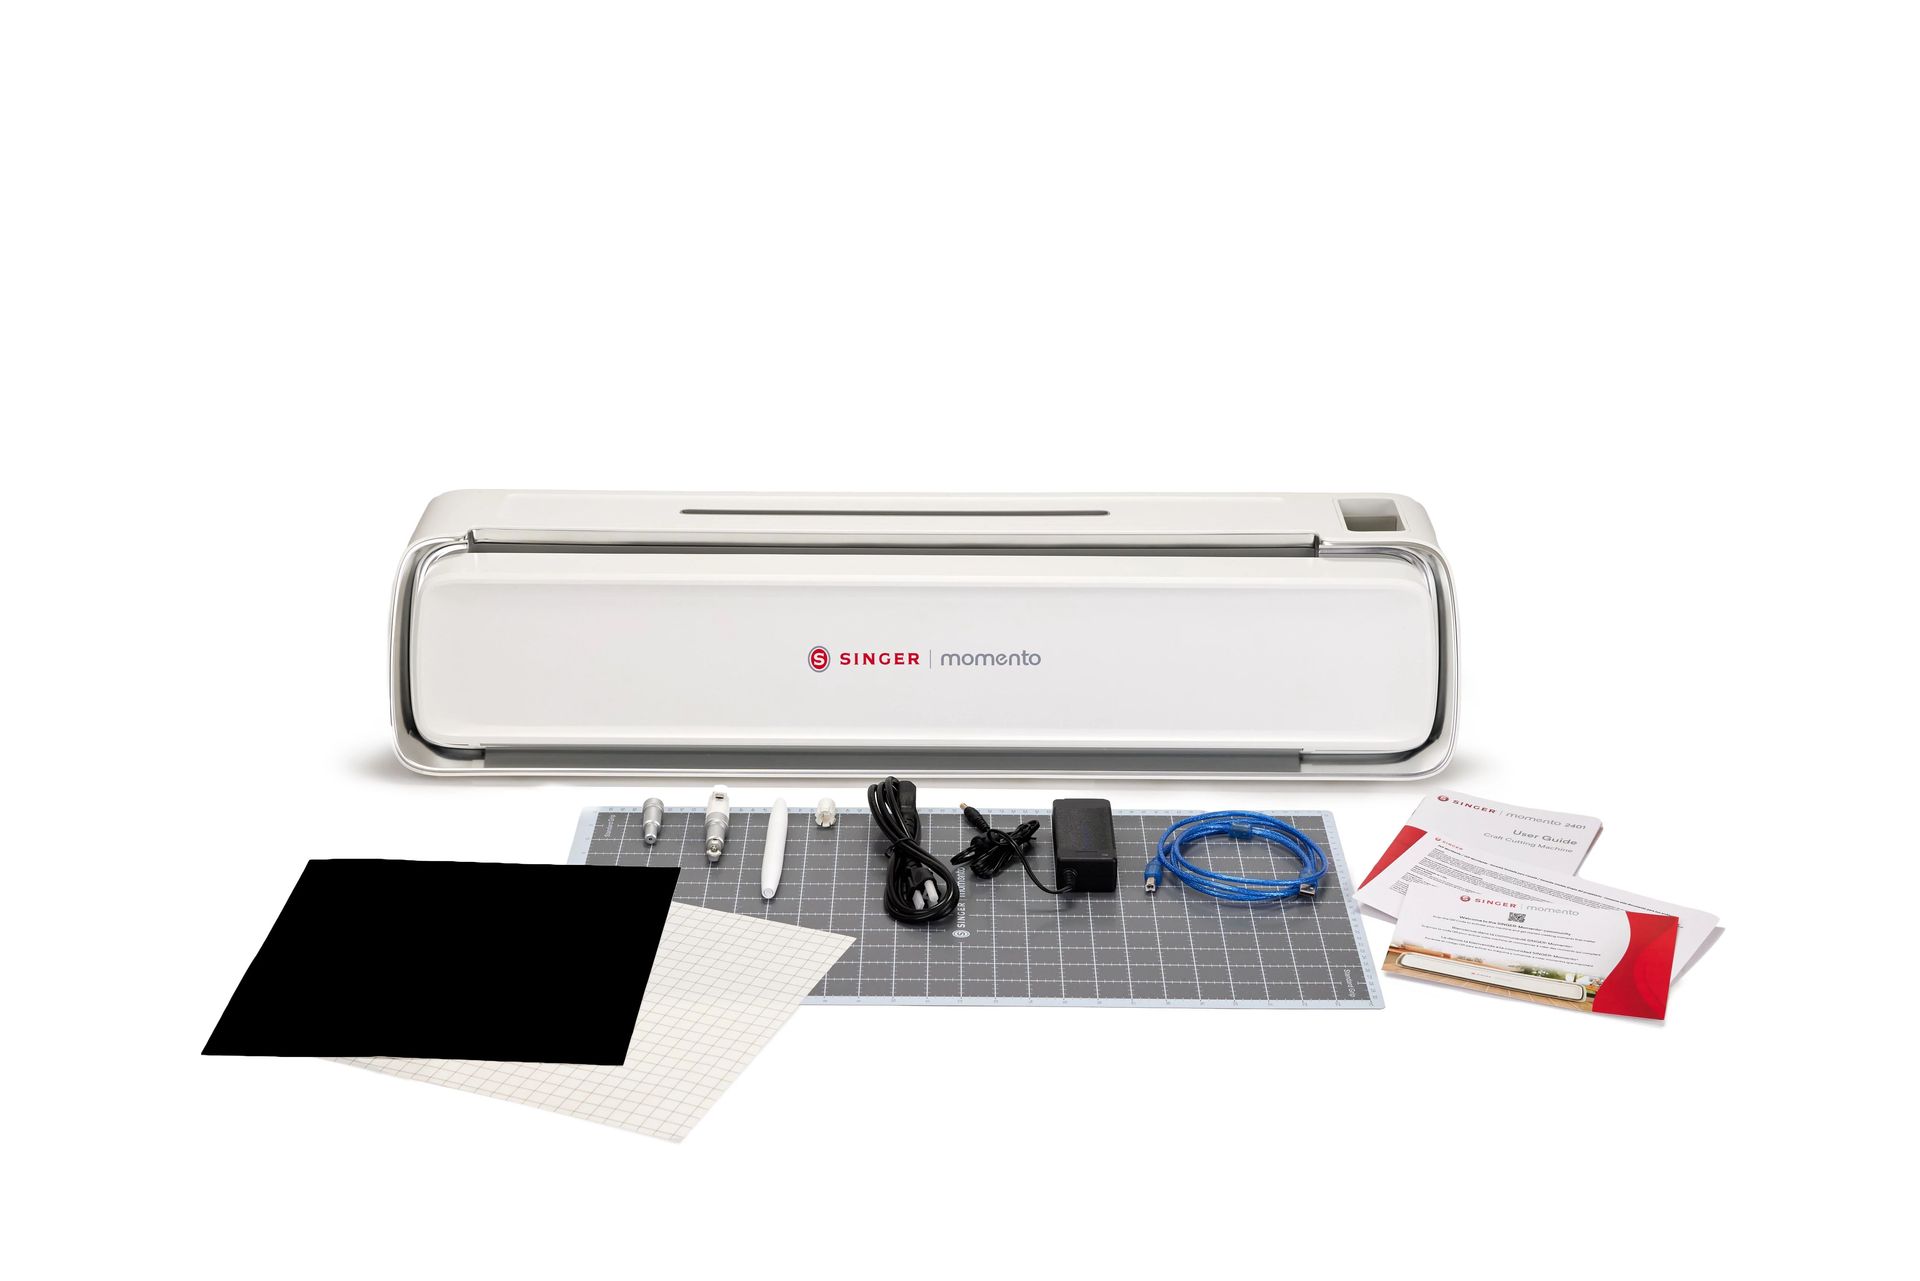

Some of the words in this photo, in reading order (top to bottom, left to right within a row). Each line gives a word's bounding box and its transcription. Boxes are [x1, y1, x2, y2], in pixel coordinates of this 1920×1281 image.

[839, 652, 920, 665] SINGER
[940, 650, 1042, 666] momento
[1452, 799, 1496, 814] SINGER
[1505, 811, 1562, 826] momento
[1564, 822, 1586, 830] 2401
[1442, 840, 1463, 851] SINGER
[1483, 832, 1504, 841] Craft
[1505, 836, 1537, 848] Cutting
[1537, 842, 1574, 853] Machine
[1513, 829, 1539, 840] User
[1542, 834, 1578, 846] Guide
[957, 903, 966, 928] SINGER
[1475, 898, 1517, 908] SINGER
[1526, 905, 1579, 916] momento
